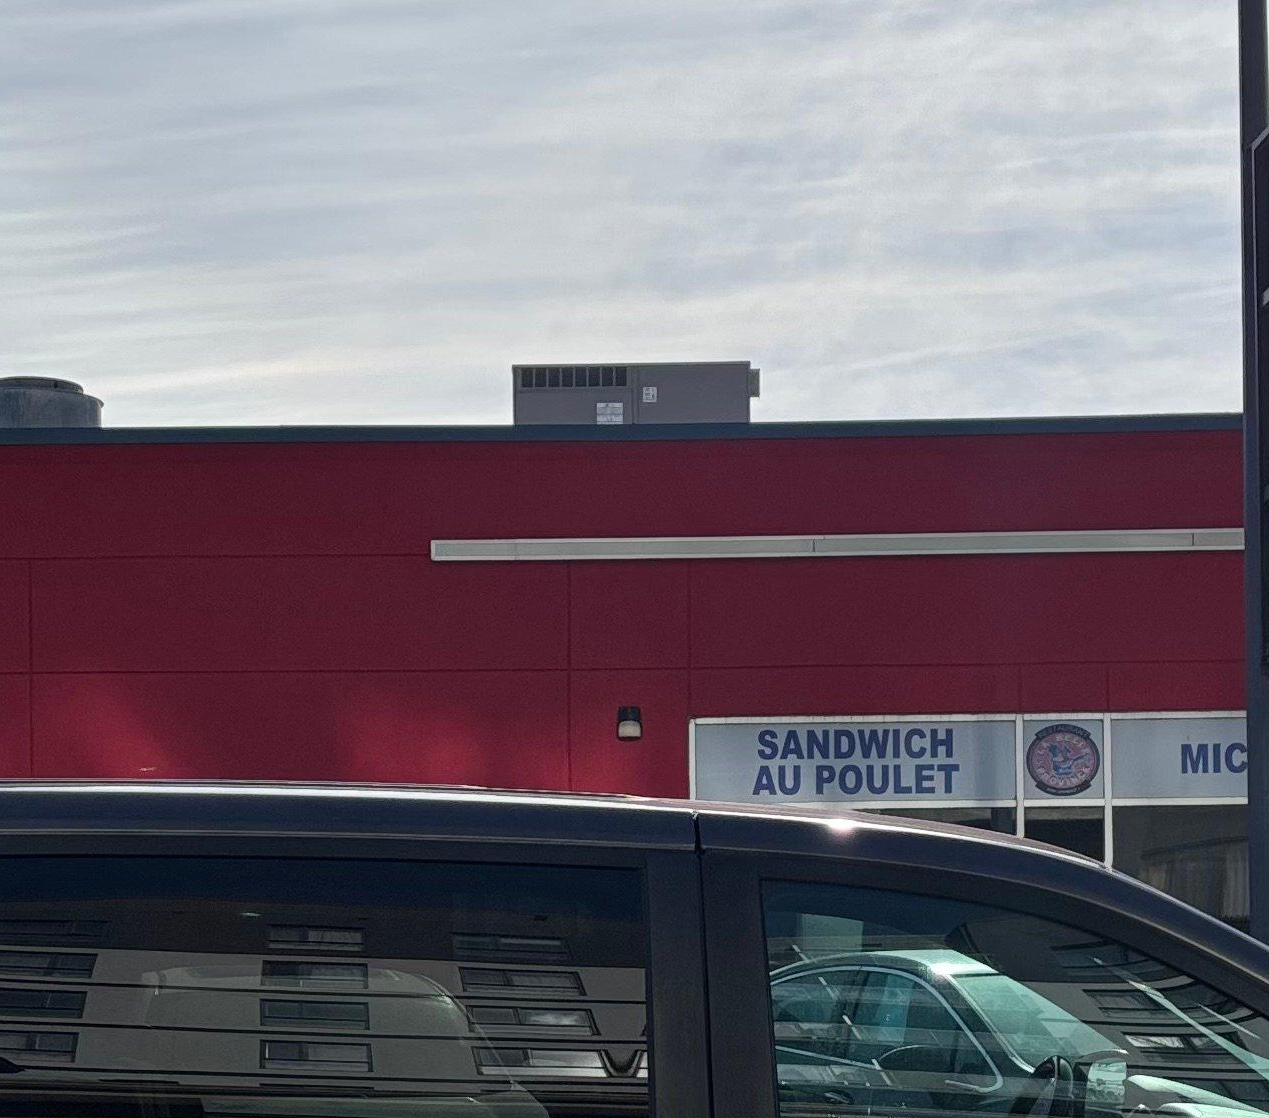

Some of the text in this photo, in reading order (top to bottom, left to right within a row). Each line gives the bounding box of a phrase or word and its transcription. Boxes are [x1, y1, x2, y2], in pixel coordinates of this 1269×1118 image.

[757, 728, 954, 760] SANDWICH
[752, 763, 960, 796] AU POULET
